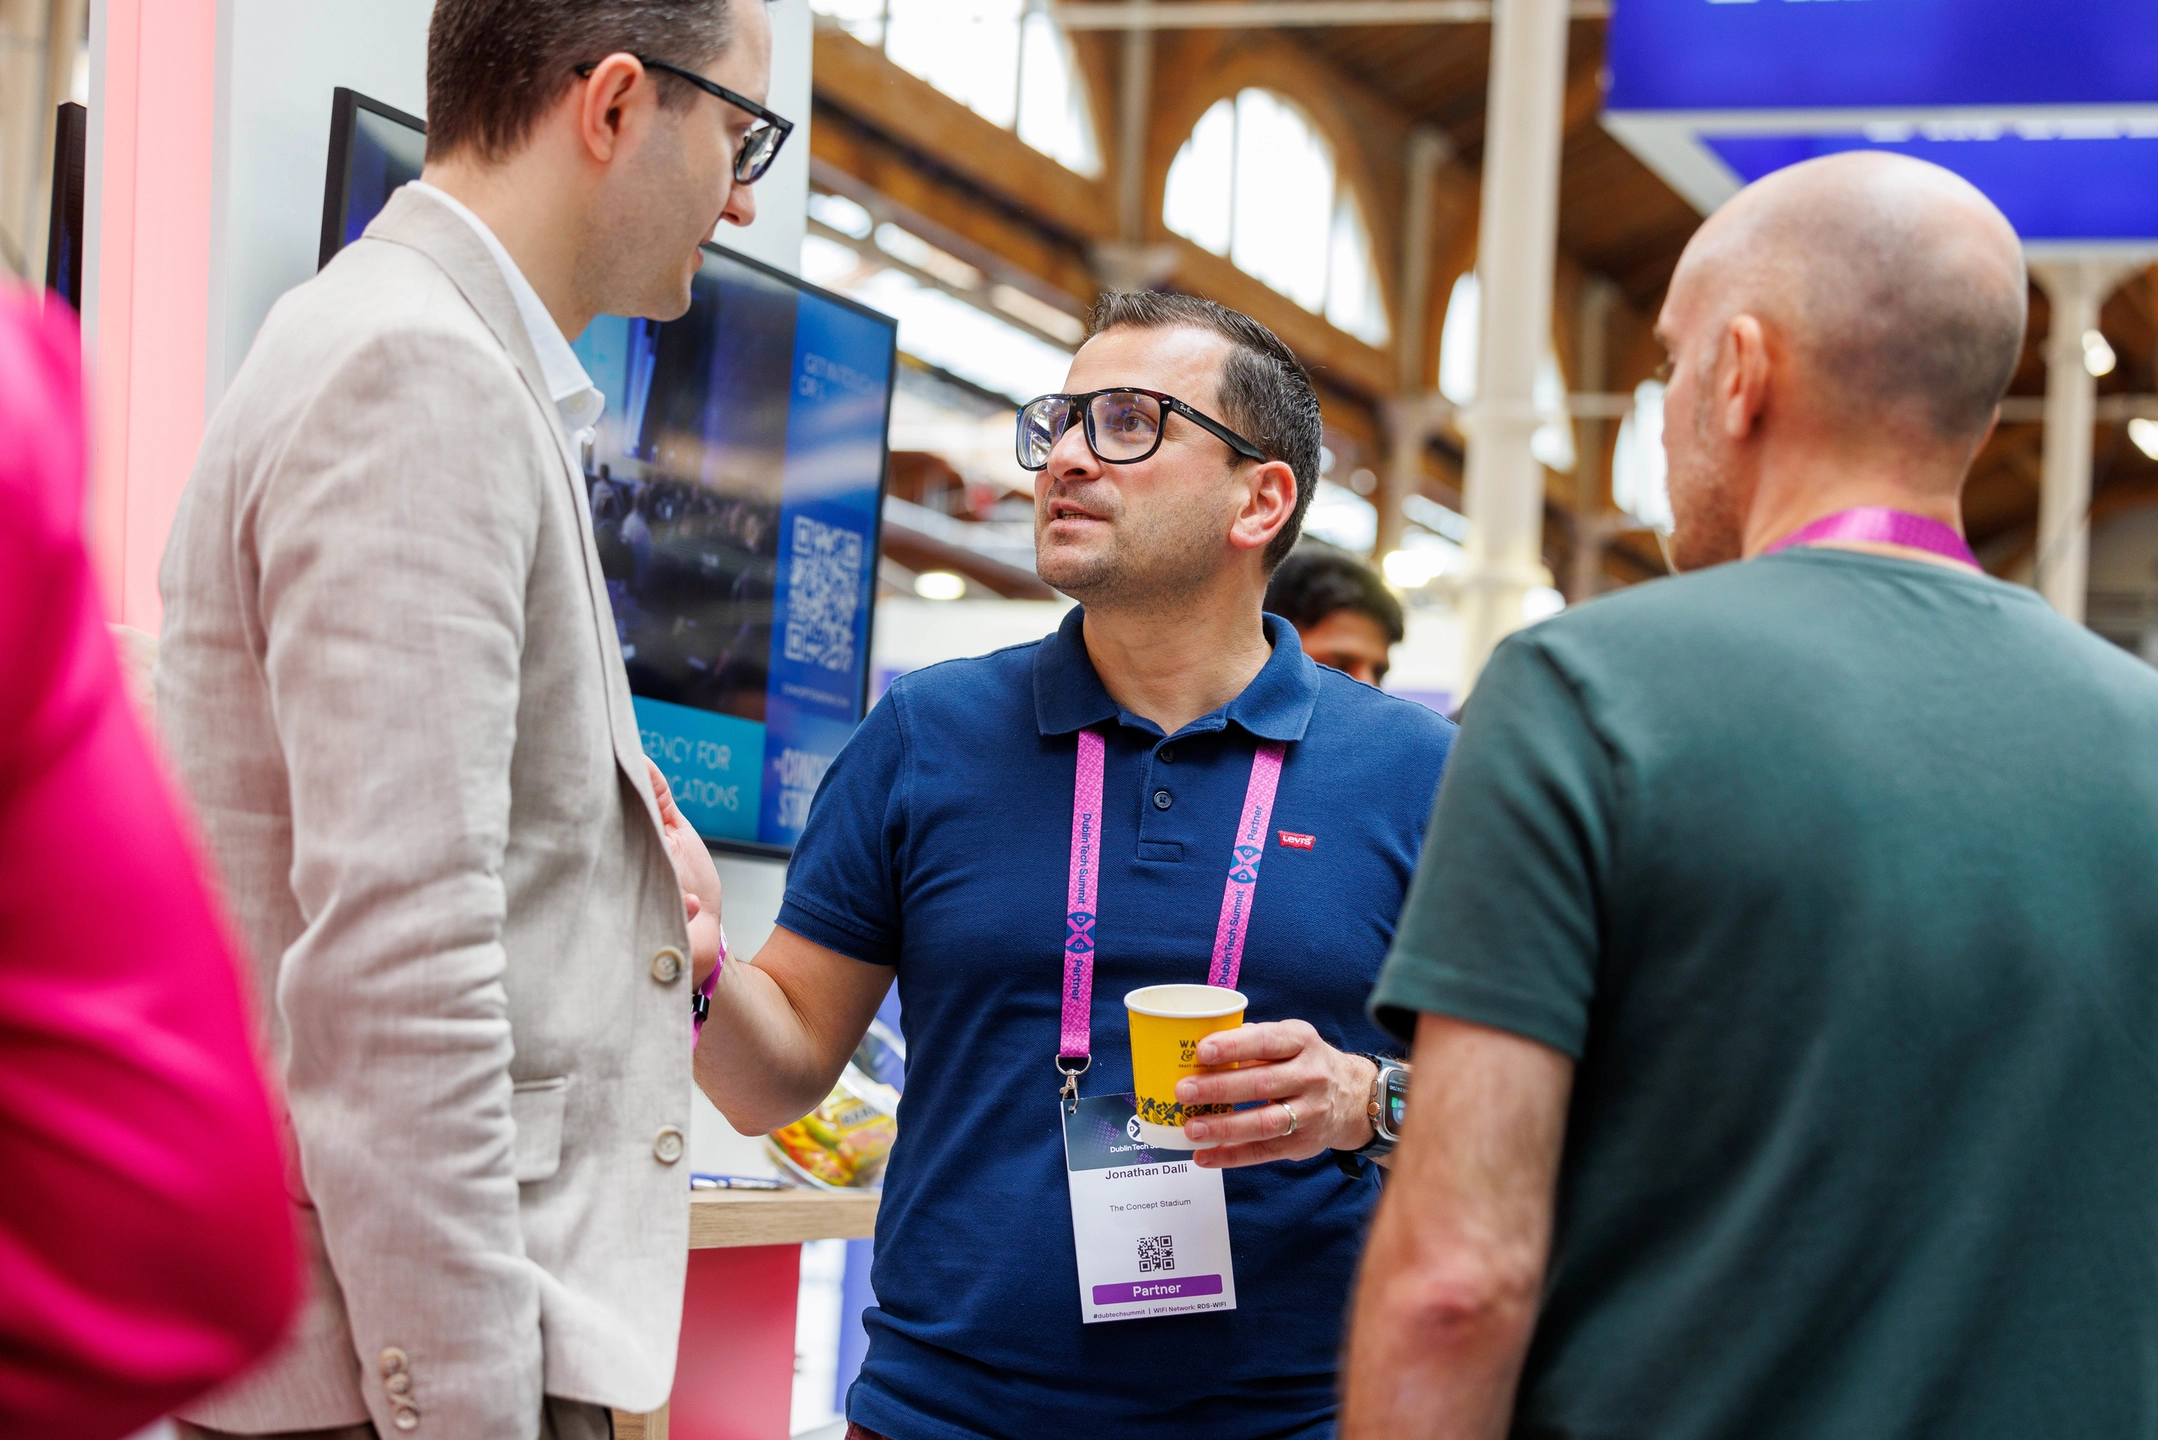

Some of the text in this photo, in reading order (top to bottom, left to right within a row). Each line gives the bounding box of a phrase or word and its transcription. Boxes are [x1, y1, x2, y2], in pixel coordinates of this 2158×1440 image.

[639, 729, 732, 771] GENCY FOR
[670, 775, 739, 811] CATIONS
[1247, 805, 1263, 840] Partner
[1078, 813, 1092, 904] Dublin Tech Summit
[1218, 890, 1245, 985] Dublin Tech Summit
[1071, 960, 1083, 1001] Partner
[1179, 1040, 1200, 1048] WA
[1181, 1049, 1195, 1062] &
[1110, 1144, 1132, 1153] Dublin
[1132, 1143, 1149, 1151] Tech
[1105, 1163, 1188, 1180] Jonathan Dalli
[1109, 1199, 1191, 1212] The Concept Stadium
[1132, 1283, 1182, 1297] Partner
[1093, 1309, 1146, 1319] #dubtechsummit
[1168, 1305, 1196, 1313] Network:
[1197, 1302, 1227, 1310] RDS-WIFI
